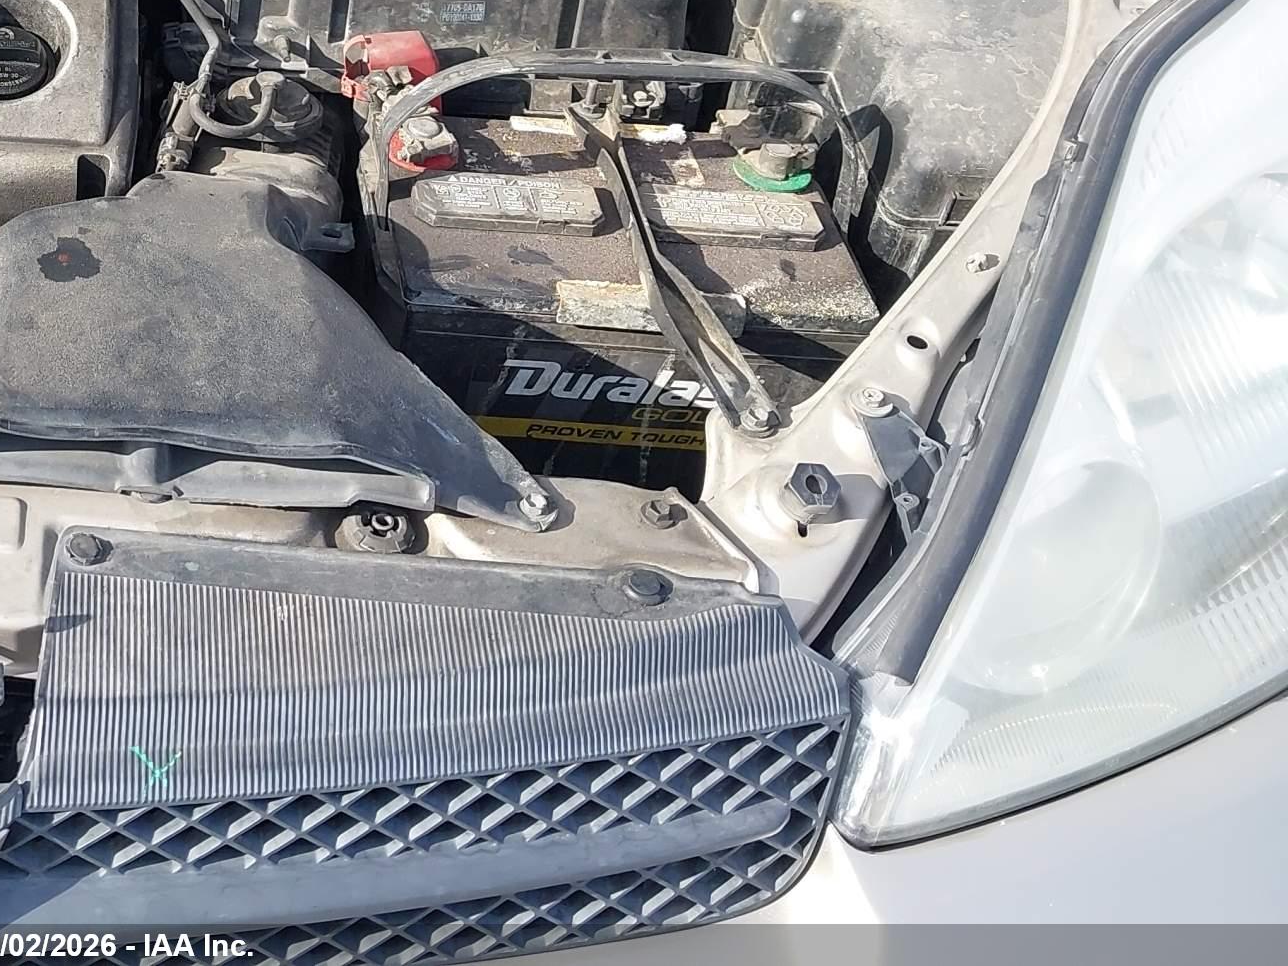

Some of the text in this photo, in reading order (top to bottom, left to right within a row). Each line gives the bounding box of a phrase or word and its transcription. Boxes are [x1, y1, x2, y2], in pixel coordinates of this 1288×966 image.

[460, 176, 506, 185] DANGER
[518, 180, 560, 189] POISON
[503, 359, 718, 409] Duralas
[527, 423, 705, 447] PROVEN TOUGH
